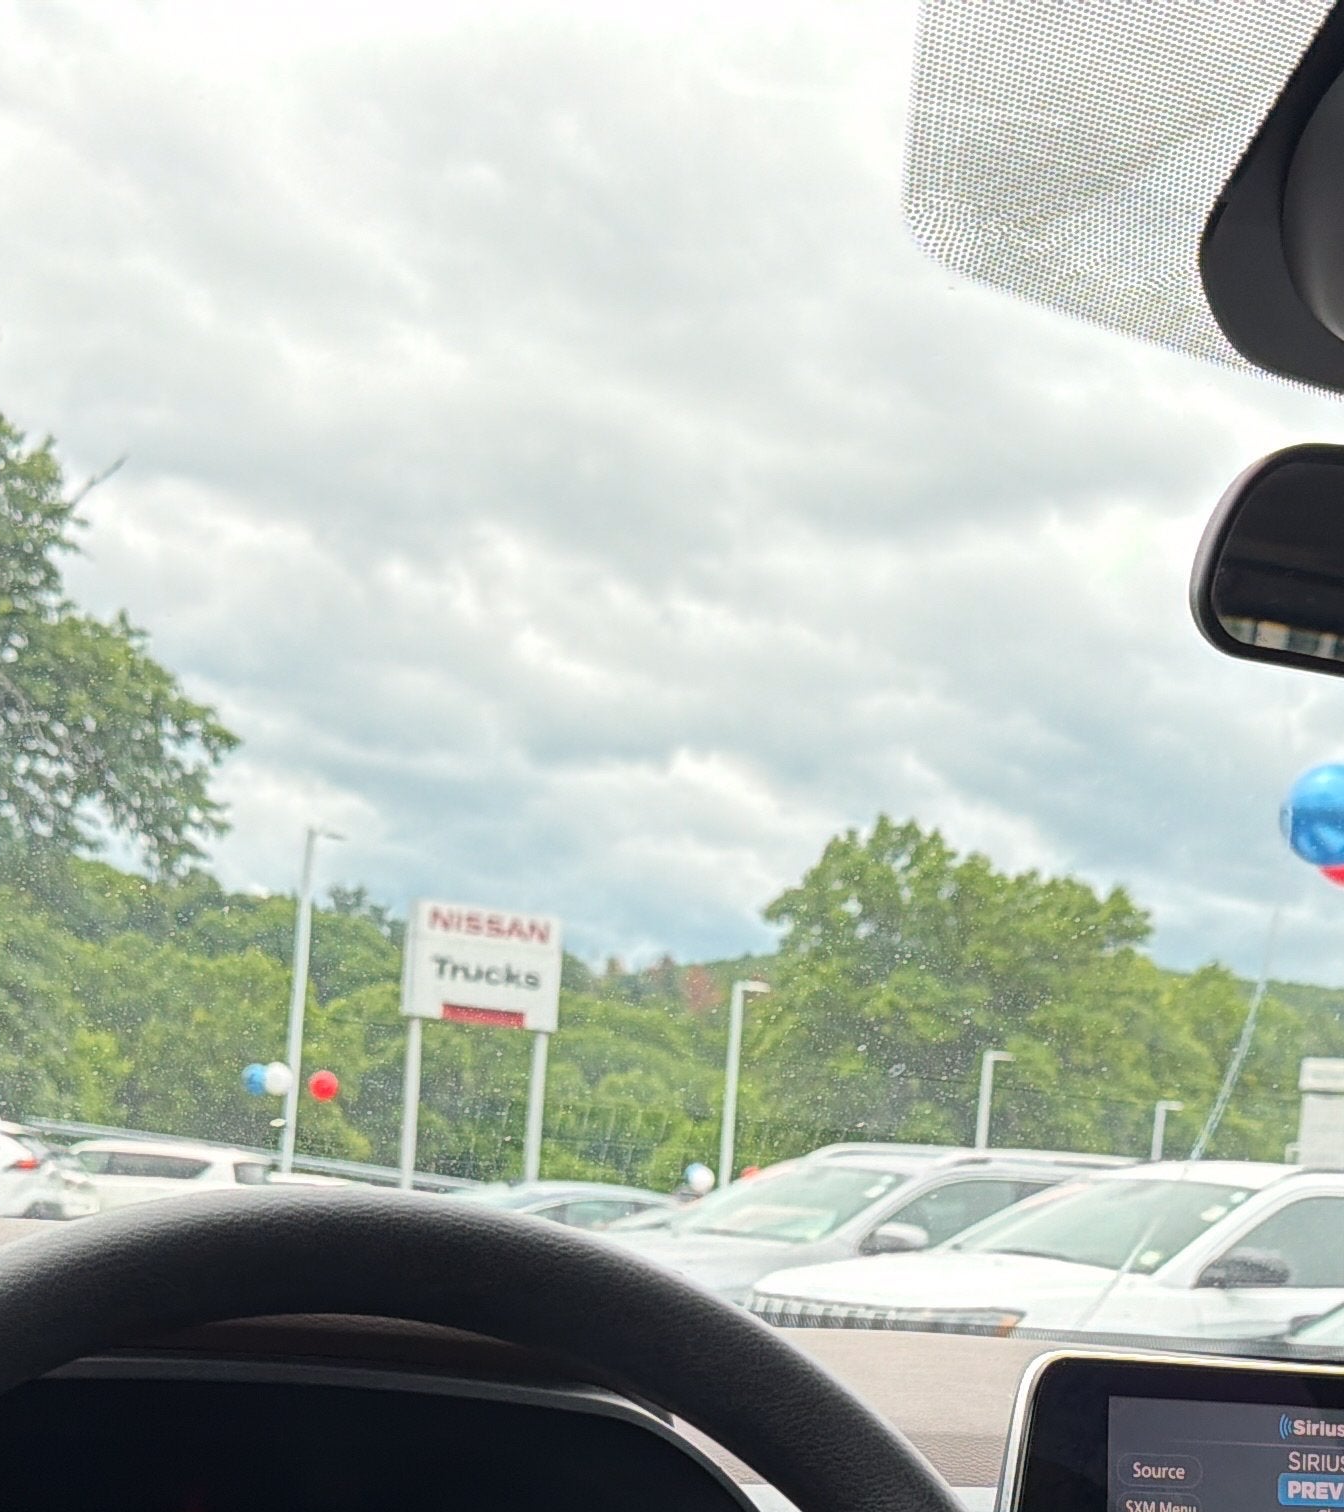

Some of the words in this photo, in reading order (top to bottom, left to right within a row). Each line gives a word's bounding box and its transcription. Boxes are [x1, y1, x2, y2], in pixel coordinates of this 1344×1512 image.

[427, 906, 552, 945] NISSAN
[432, 954, 542, 991] Trucks
[1132, 1461, 1185, 1480] Source
